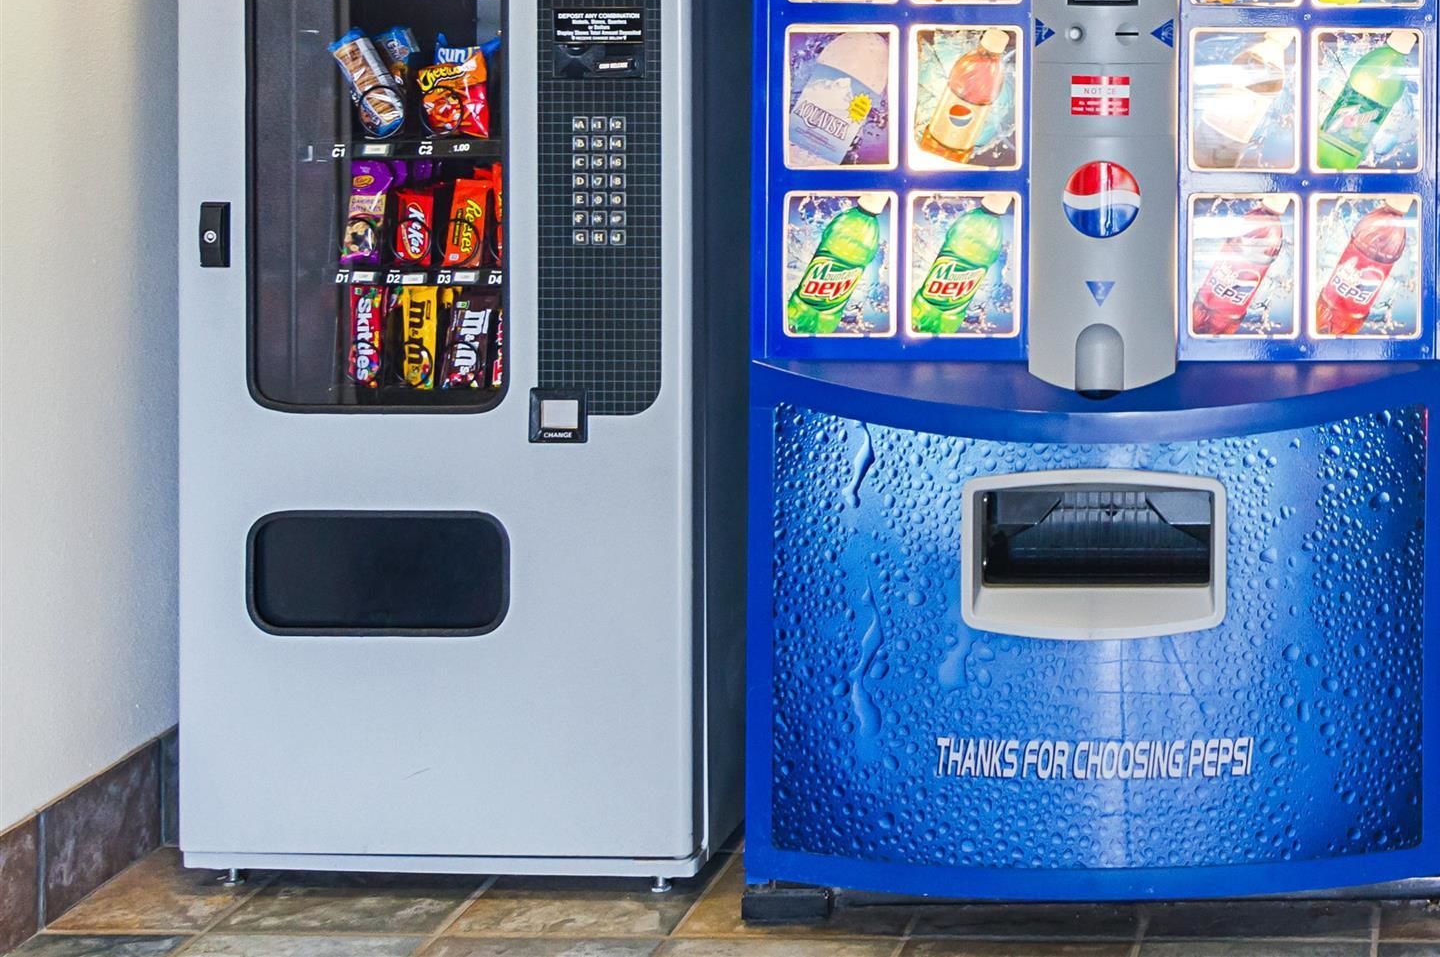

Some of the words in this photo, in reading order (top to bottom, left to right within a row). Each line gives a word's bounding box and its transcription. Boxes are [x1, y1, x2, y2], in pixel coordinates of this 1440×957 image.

[1084, 87, 1117, 96] NOTCE
[576, 121, 585, 129] A
[794, 99, 850, 141] AQUAVISTA
[576, 139, 585, 147] B
[331, 147, 346, 158] C1
[418, 145, 433, 156] C2
[453, 144, 470, 153] 1.00
[576, 157, 585, 166] C
[576, 176, 585, 185] D
[576, 195, 585, 204] E
[461, 199, 482, 253] Reese's
[335, 274, 349, 284] D1
[386, 274, 400, 284] D2
[437, 274, 451, 284] D3
[488, 274, 502, 284] D4
[804, 280, 852, 301] DEW
[927, 280, 976, 301] DEW
[1208, 277, 1250, 305] PEPSI
[1331, 276, 1374, 305] PEPSI
[356, 297, 373, 381] Skittles
[543, 431, 572, 439] CHANGE
[937, 736, 1019, 778] THANKS
[1022, 740, 1068, 779] FOR
[1072, 739, 1184, 779] CHOOSING
[1188, 736, 1254, 778] PEPSI
